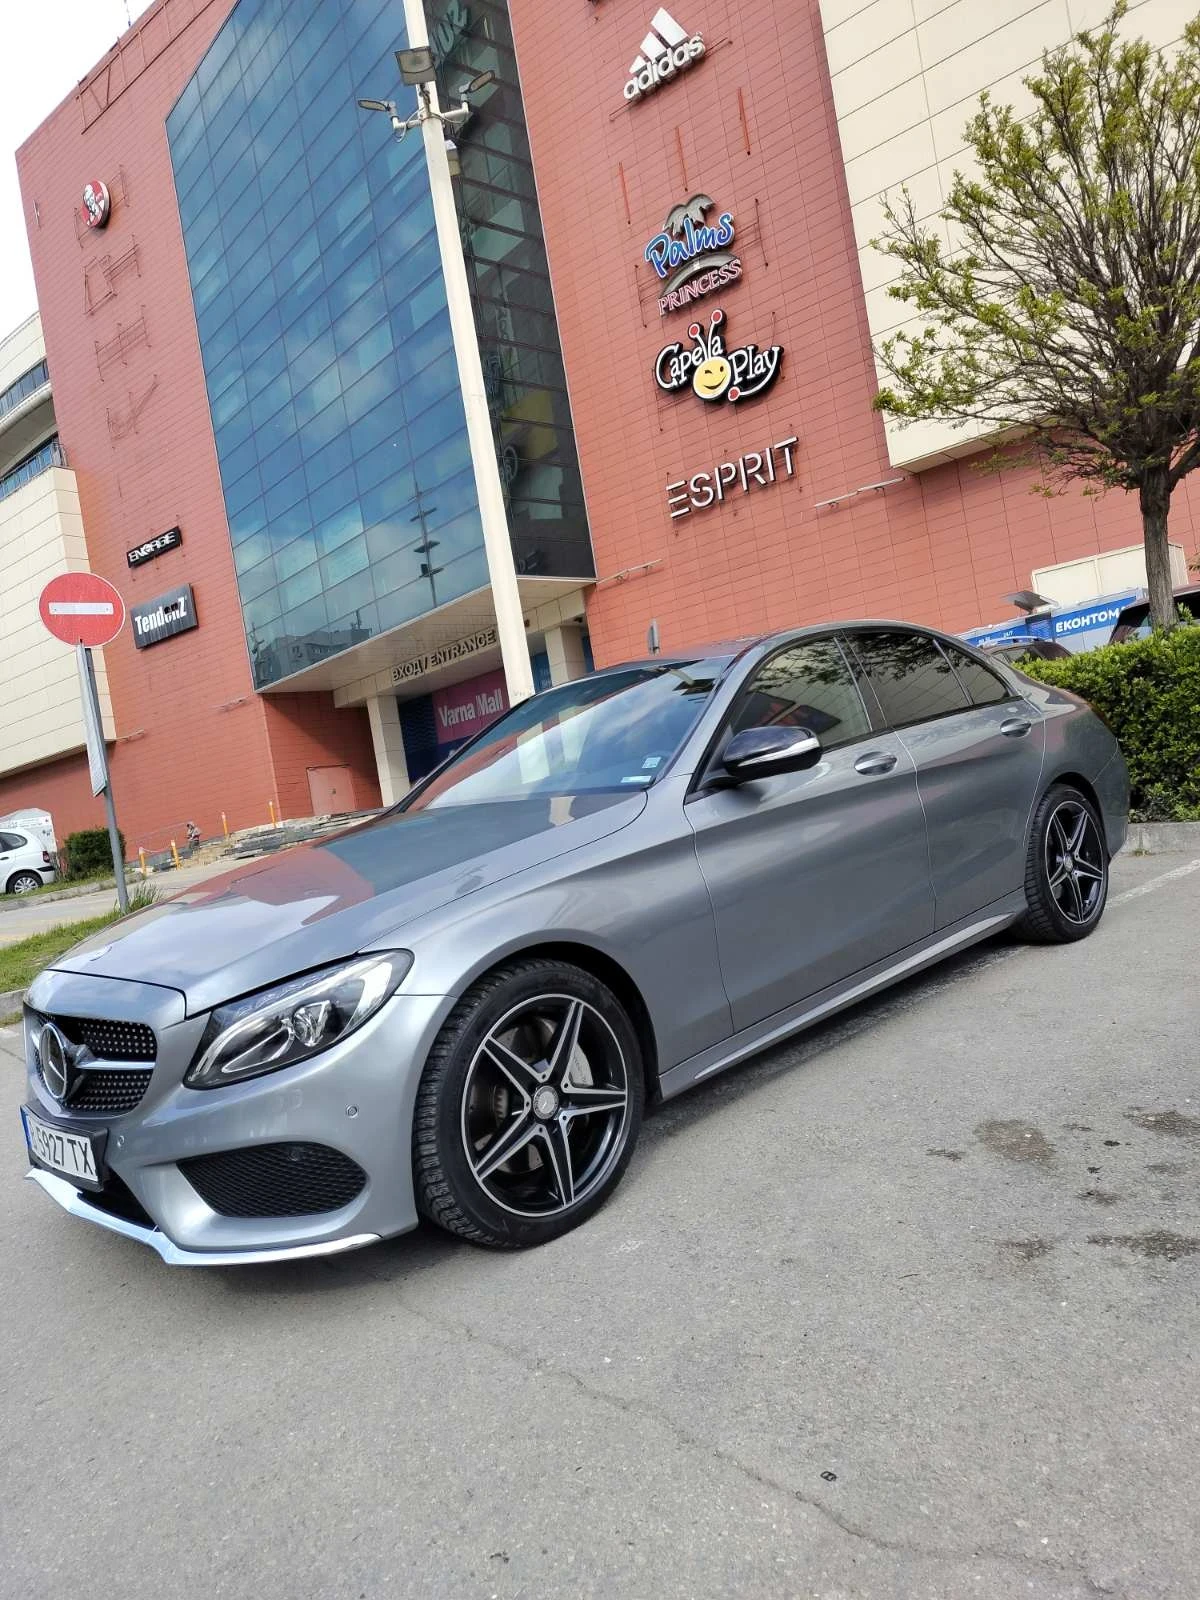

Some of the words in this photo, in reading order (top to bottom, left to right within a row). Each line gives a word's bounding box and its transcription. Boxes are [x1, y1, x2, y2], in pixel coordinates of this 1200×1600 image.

[623, 35, 706, 101] adidas
[644, 212, 735, 279] Palms
[658, 258, 742, 317] PRINCESS
[655, 310, 724, 389] Capella
[727, 345, 780, 401] Play
[665, 435, 799, 519] ESPRIT
[1055, 605, 1127, 633] ЕКОНТОМ
[392, 658, 423, 682] ВХОД
[431, 629, 497, 667] ENTRANCE
[438, 703, 476, 728] Varna
[475, 689, 504, 716] Mall
[67, 1138, 94, 1176] TX
